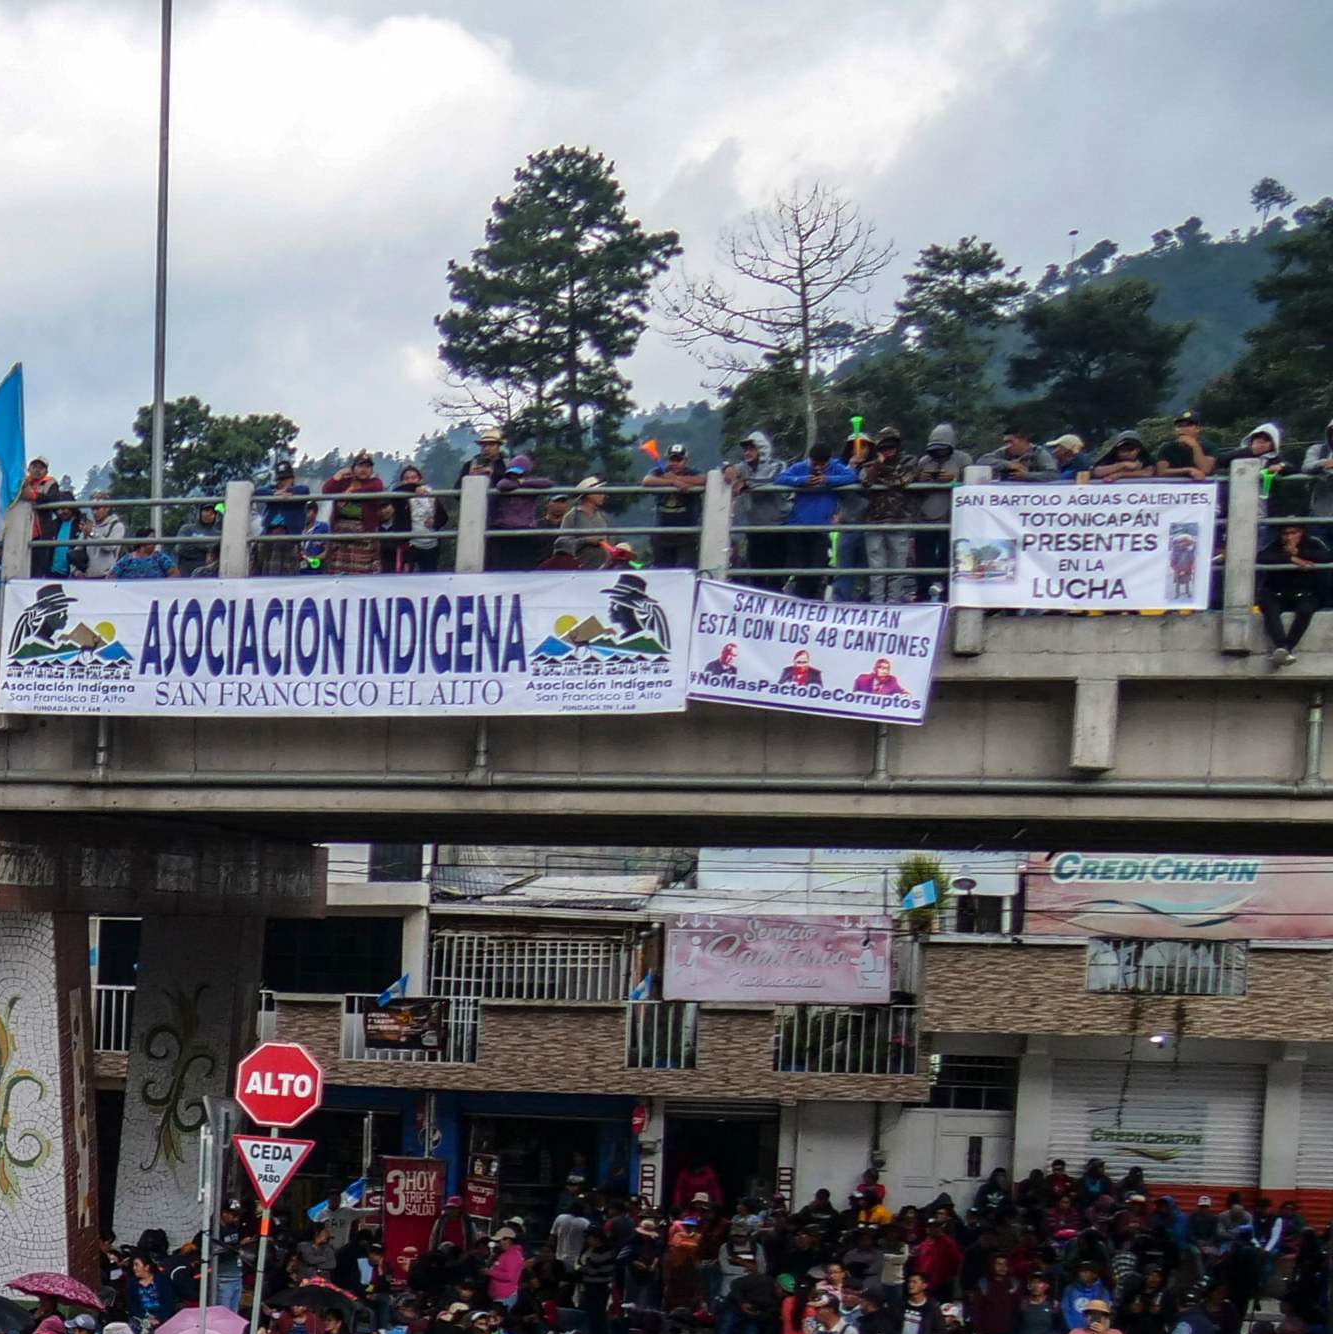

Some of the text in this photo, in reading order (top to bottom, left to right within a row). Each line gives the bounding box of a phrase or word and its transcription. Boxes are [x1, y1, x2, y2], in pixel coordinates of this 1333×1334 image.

[955, 495, 984, 507] SAN
[990, 494, 1061, 506] BARTOLO
[1067, 494, 1122, 506] AGUAS
[1019, 509, 1160, 527] TOTONICAPÁN
[1022, 533, 1158, 552] PRESENTES
[1059, 559, 1104, 572] EN LA
[1032, 577, 1128, 600] LUCHA
[734, 592, 901, 629] SAN MATEO IXTATÁN
[139, 593, 527, 677] ASOCIACION INDIGENA
[697, 612, 930, 659] ESTÁ CON LOS 48 CANTONES
[2, 681, 74, 693] Asociación
[155, 679, 503, 707] SAN FRANCISCO EL ALTO
[526, 678, 604, 691] Asociación
[689, 670, 921, 711] #NoMasPactoDeCorruptos
[8, 693, 125, 704] San Francisco El Alto
[535, 691, 662, 702] San Francisco El Alto
[245, 1071, 312, 1098] ALTO
[250, 1143, 293, 1162] CEDA
[264, 1164, 275, 1173] EL
[258, 1173, 281, 1183] PASO
[386, 1169, 437, 1216] 3 HOY
[405, 1191, 436, 1203] TRIPLE
[404, 1203, 436, 1216] SALDO
